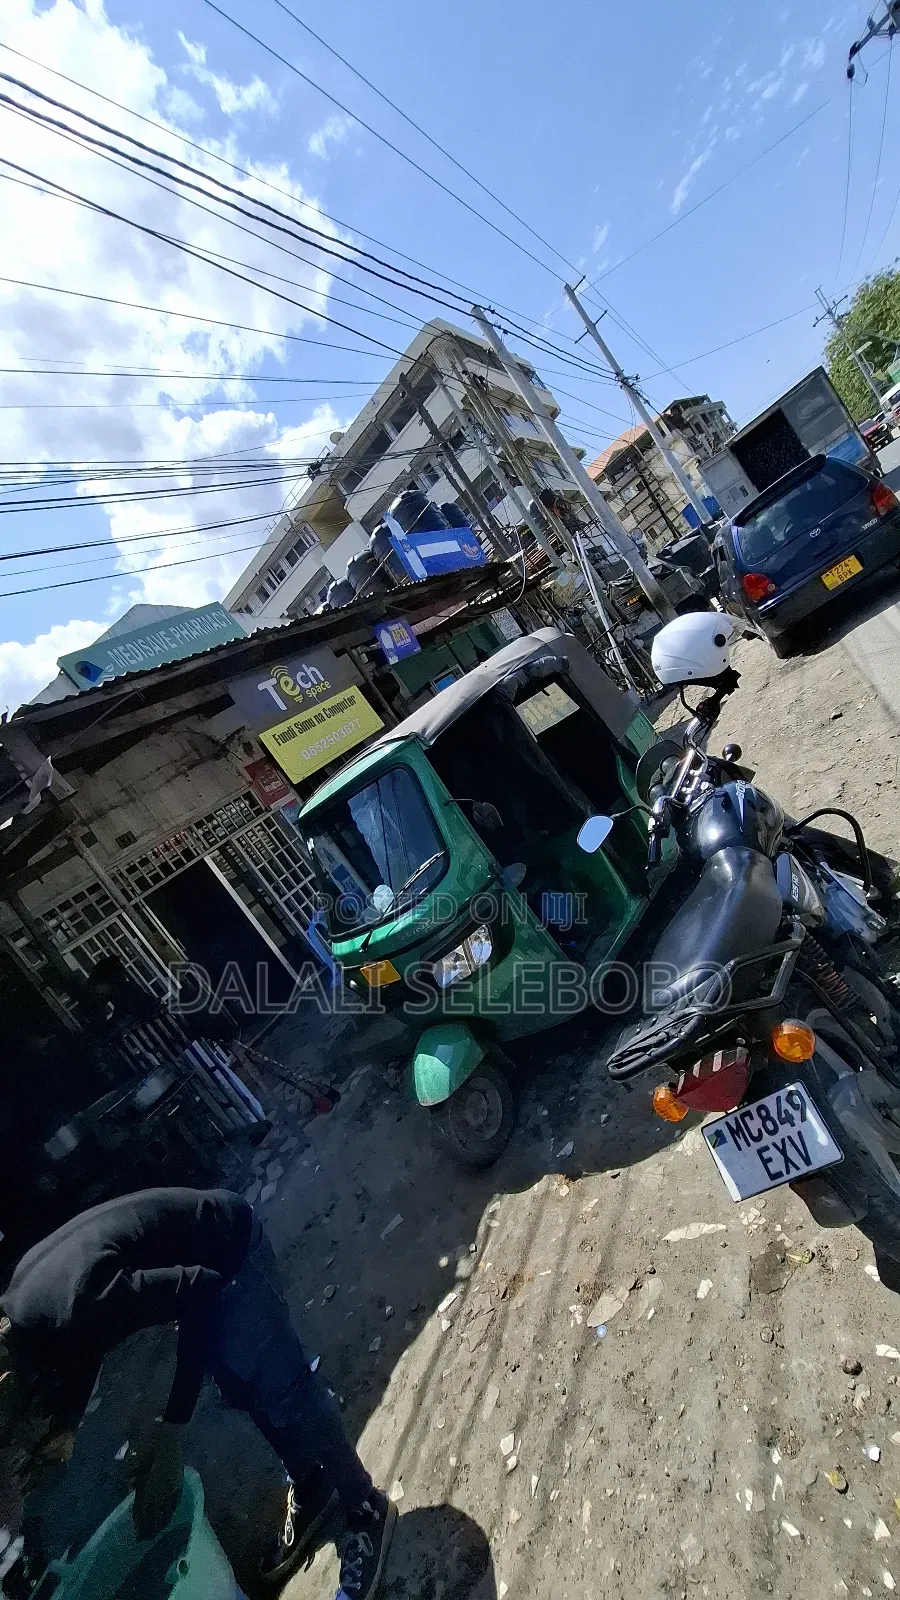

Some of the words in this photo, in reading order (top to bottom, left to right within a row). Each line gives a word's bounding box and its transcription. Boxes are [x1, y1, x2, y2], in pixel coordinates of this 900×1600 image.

[837, 568, 855, 582] BPK
[106, 628, 179, 670] MEDISAVE
[169, 607, 233, 646] PHARMACY
[257, 664, 325, 711] Tech
[305, 680, 332, 698] space
[272, 728, 297, 747] Fundi
[296, 719, 316, 735] Simu
[314, 714, 326, 727] na
[324, 694, 357, 722] Computer
[724, 1089, 807, 1152] MC849
[756, 1130, 813, 1182] EXV
